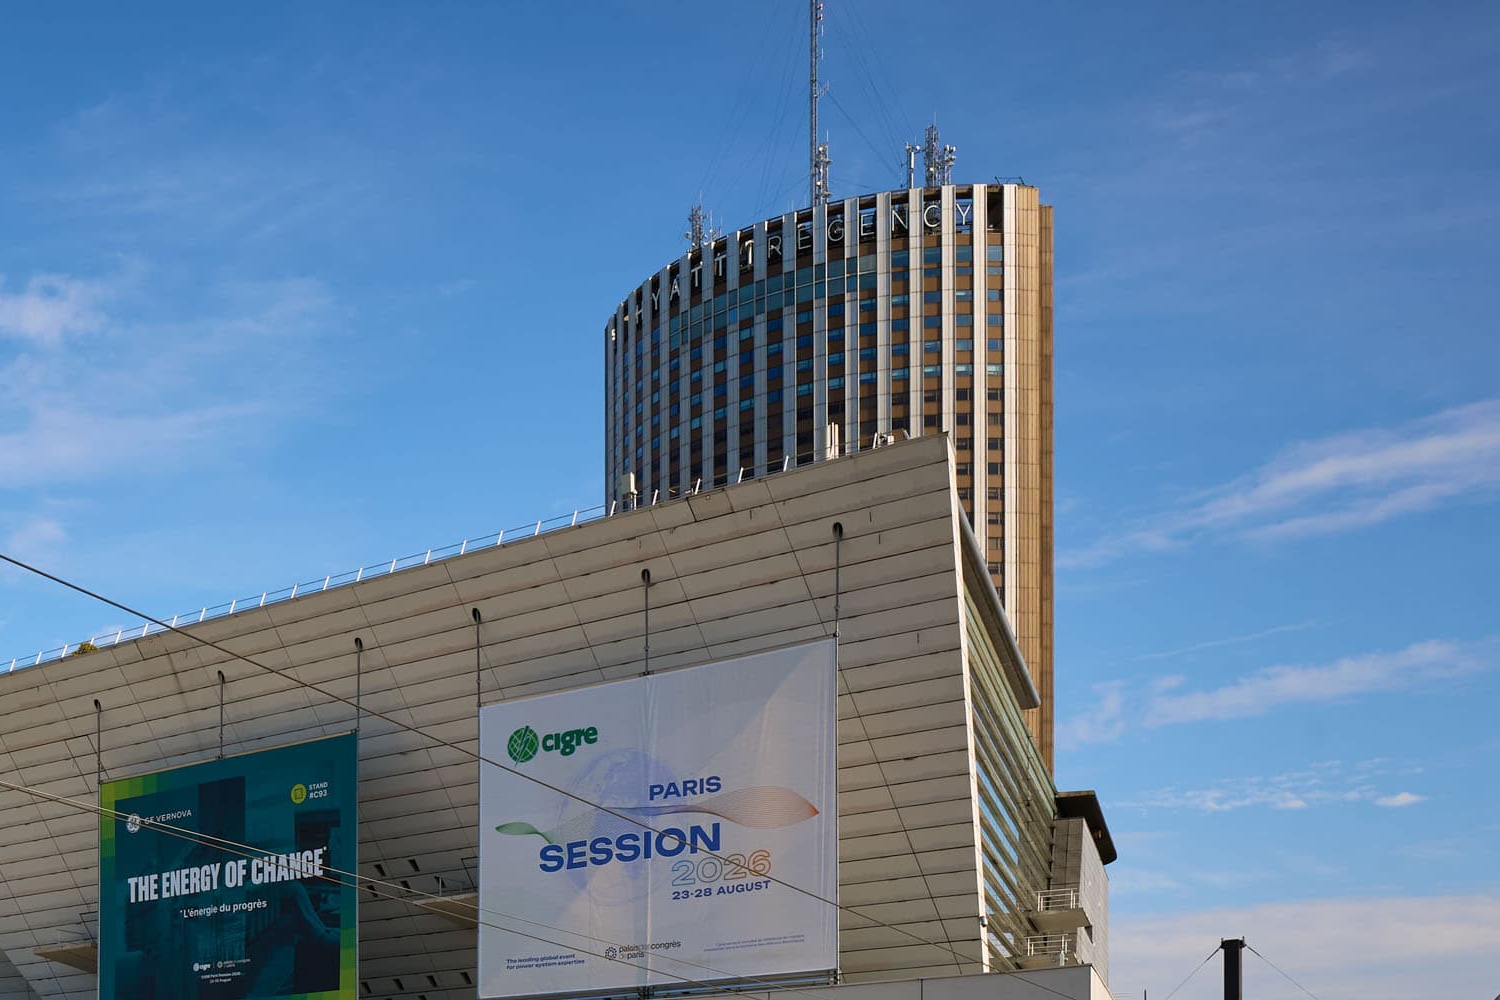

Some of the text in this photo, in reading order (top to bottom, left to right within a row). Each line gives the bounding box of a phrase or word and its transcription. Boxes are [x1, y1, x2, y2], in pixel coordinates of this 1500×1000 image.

[635, 203, 972, 324] HYATT REGENCY
[541, 725, 599, 757] cigre
[309, 781, 329, 791] STAND
[648, 775, 722, 801] PARIS
[157, 809, 192, 823] VERNOVA
[538, 822, 722, 873] SESSION
[128, 873, 159, 904] THE
[162, 862, 221, 899] ENERGY
[225, 858, 248, 889] OF
[670, 849, 772, 887] 2026
[671, 879, 771, 901] 23-28 AUGUST
[219, 902, 232, 914] du
[232, 897, 268, 913] progrès
